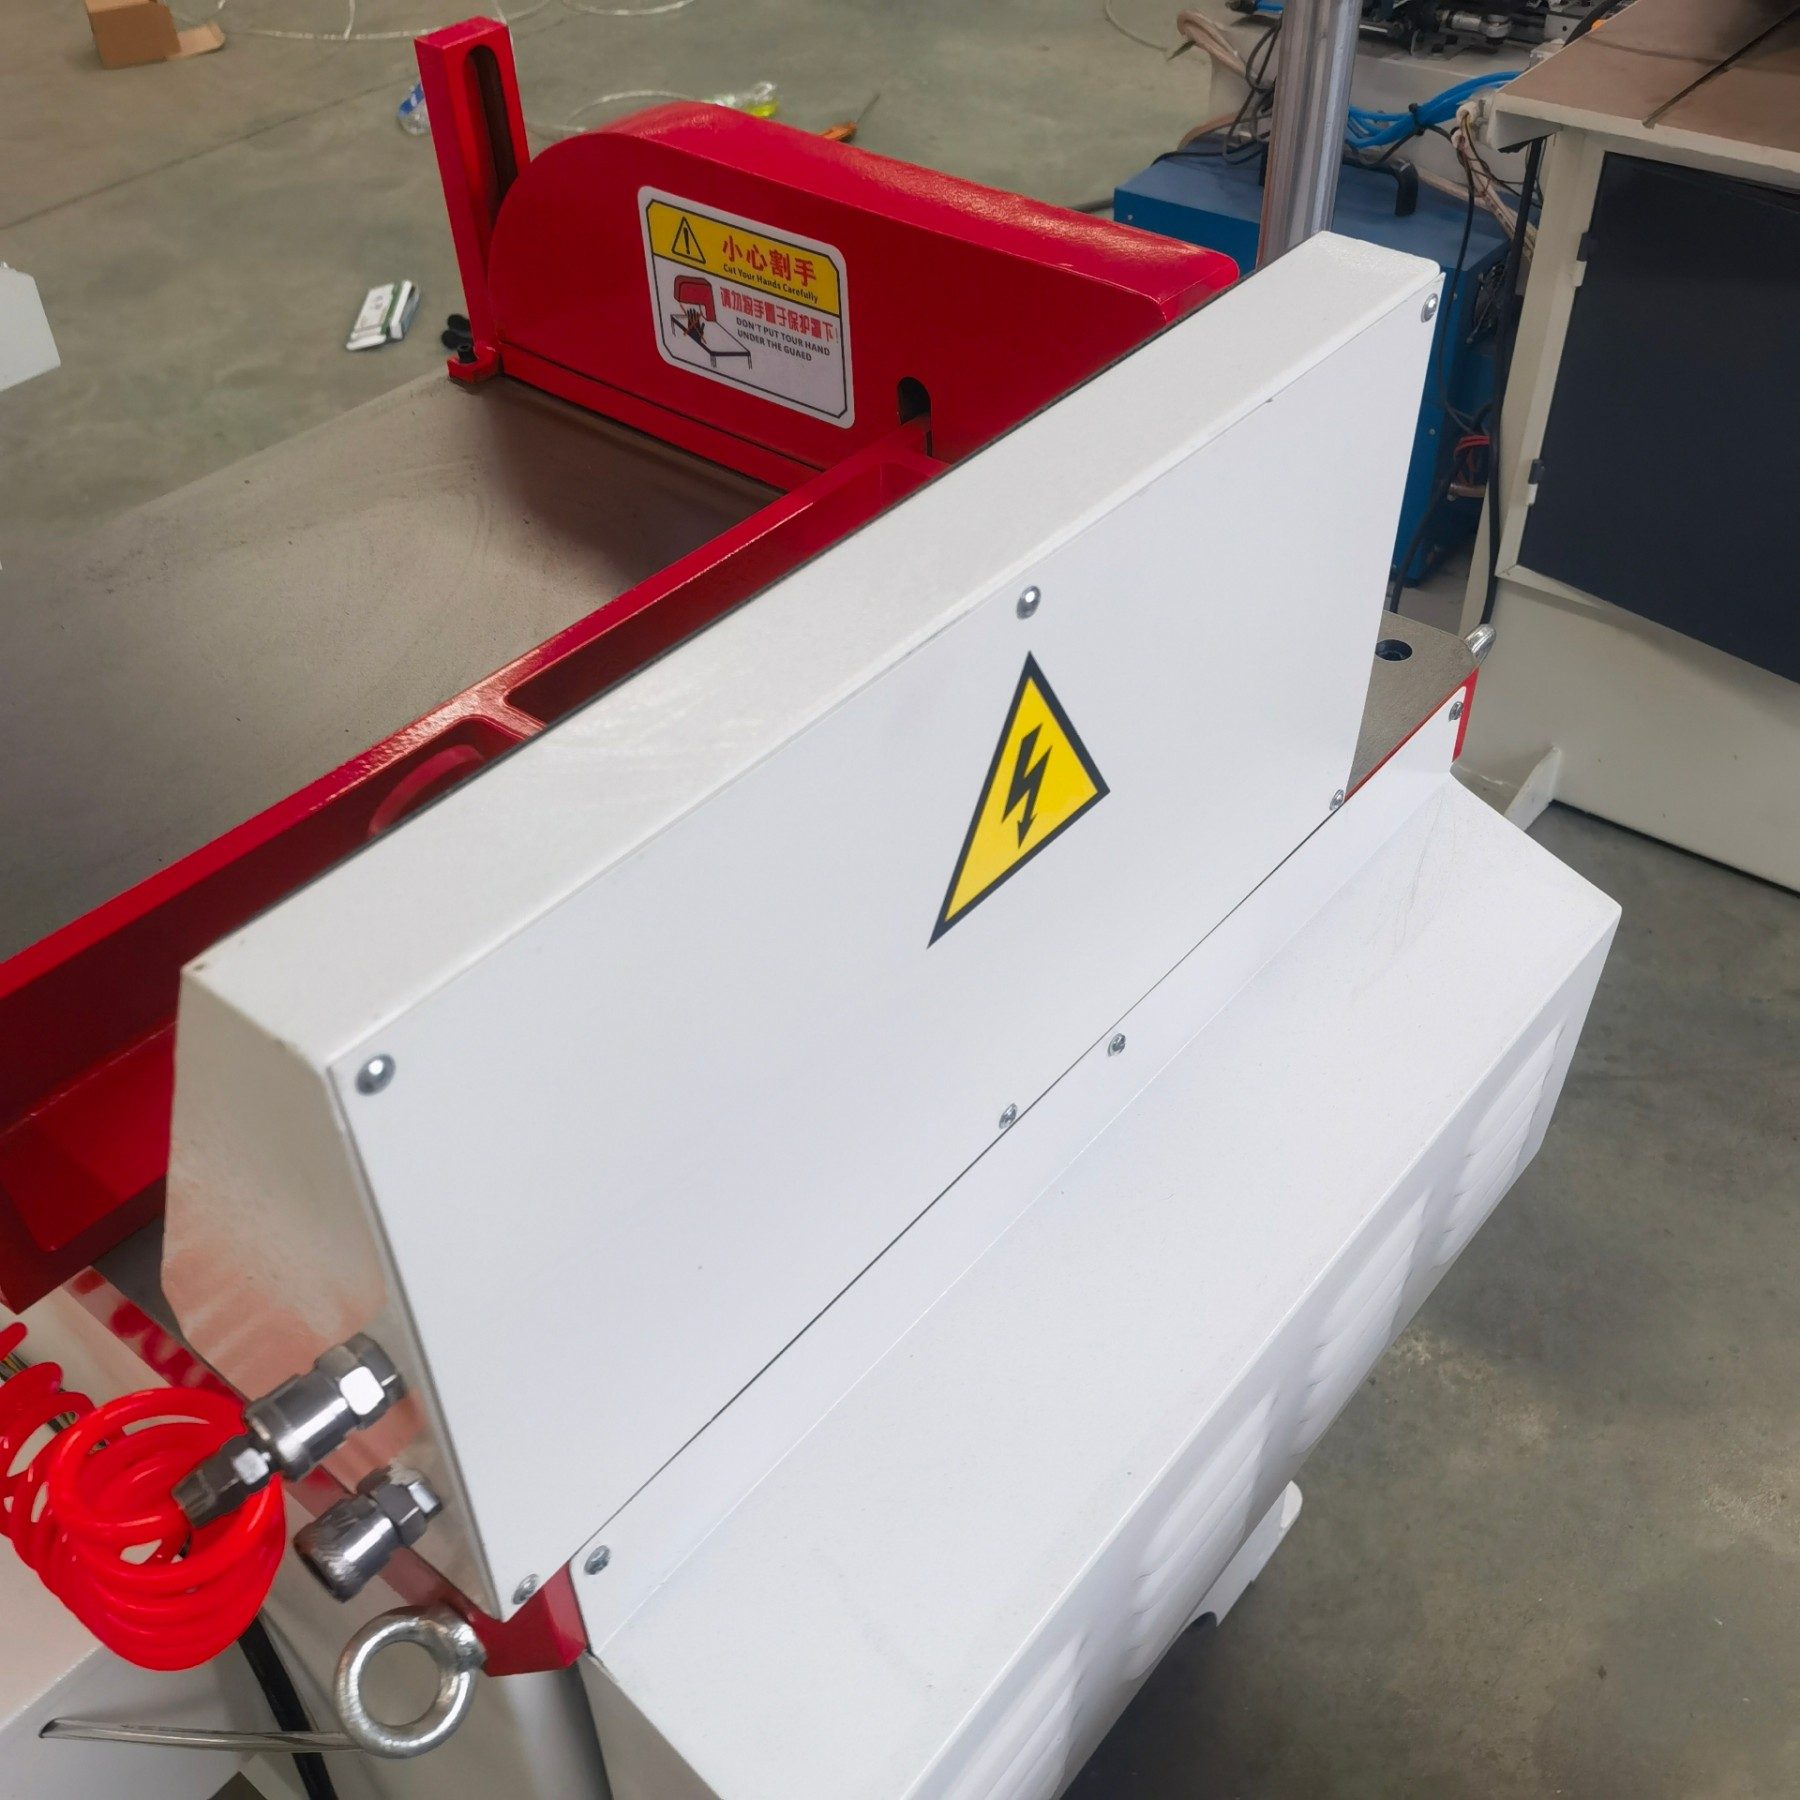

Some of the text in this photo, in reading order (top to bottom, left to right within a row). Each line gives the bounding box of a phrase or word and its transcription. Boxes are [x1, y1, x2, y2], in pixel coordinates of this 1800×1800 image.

[722, 235, 817, 287] 小心割手
[723, 263, 818, 304] Cut Your Hands Carefully
[736, 316, 761, 332] DON'T
[763, 326, 779, 338] PUT
[804, 340, 831, 356] HAND
[737, 328, 765, 345] UNDER
[766, 338, 783, 351] THE
